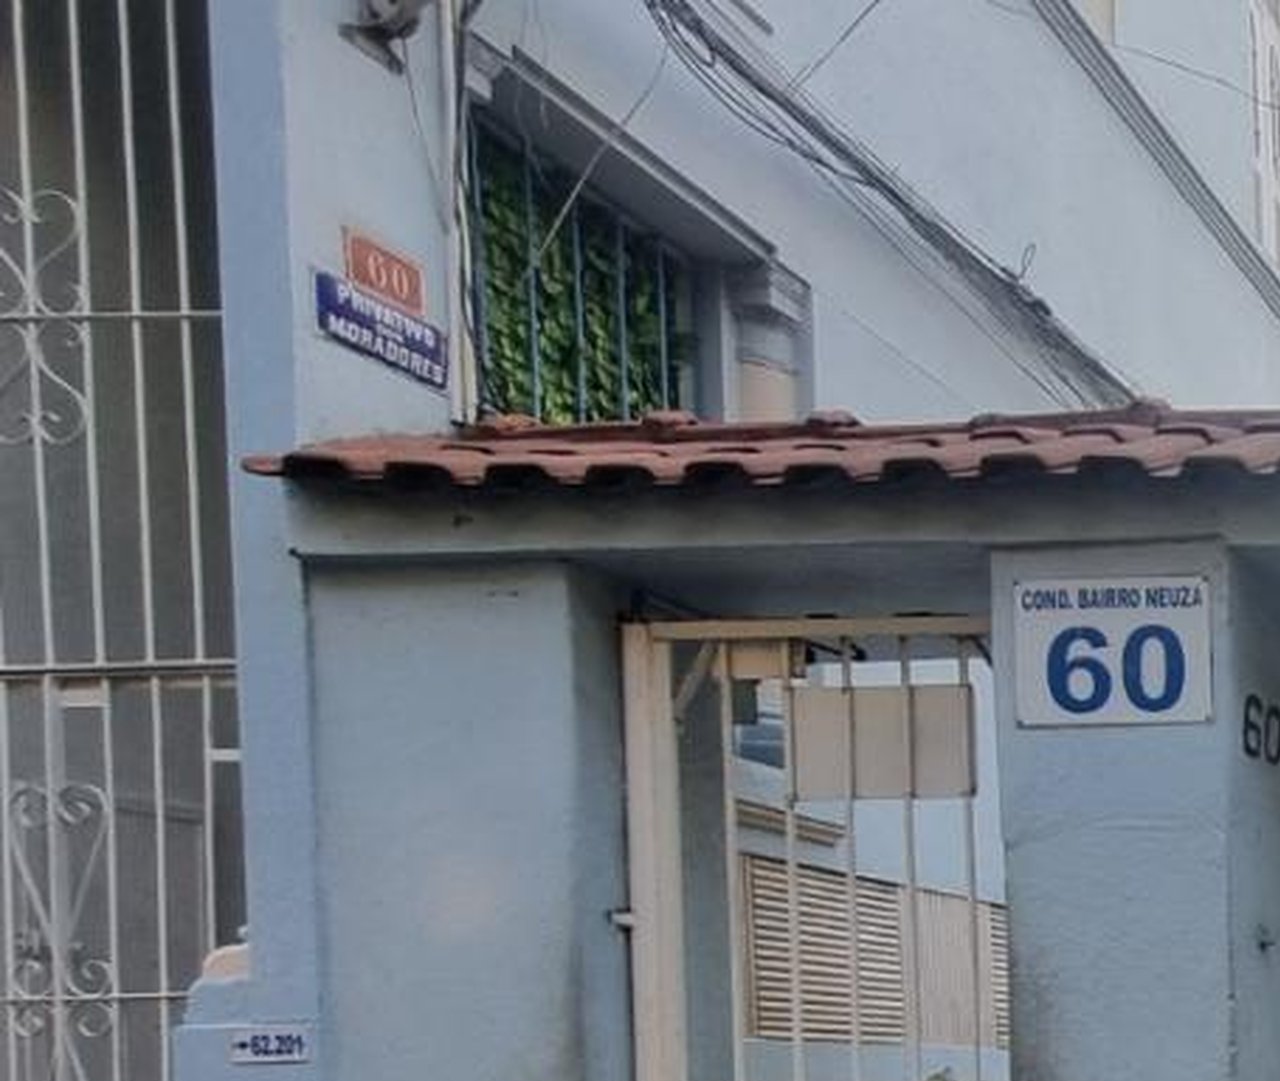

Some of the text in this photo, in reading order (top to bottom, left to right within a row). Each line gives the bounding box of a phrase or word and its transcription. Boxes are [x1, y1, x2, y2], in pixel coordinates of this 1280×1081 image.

[367, 252, 409, 300] 60
[327, 314, 445, 384] MORADORES
[1021, 586, 1202, 610] COND. BAIRRO NEUZA
[1046, 623, 1186, 714] 60
